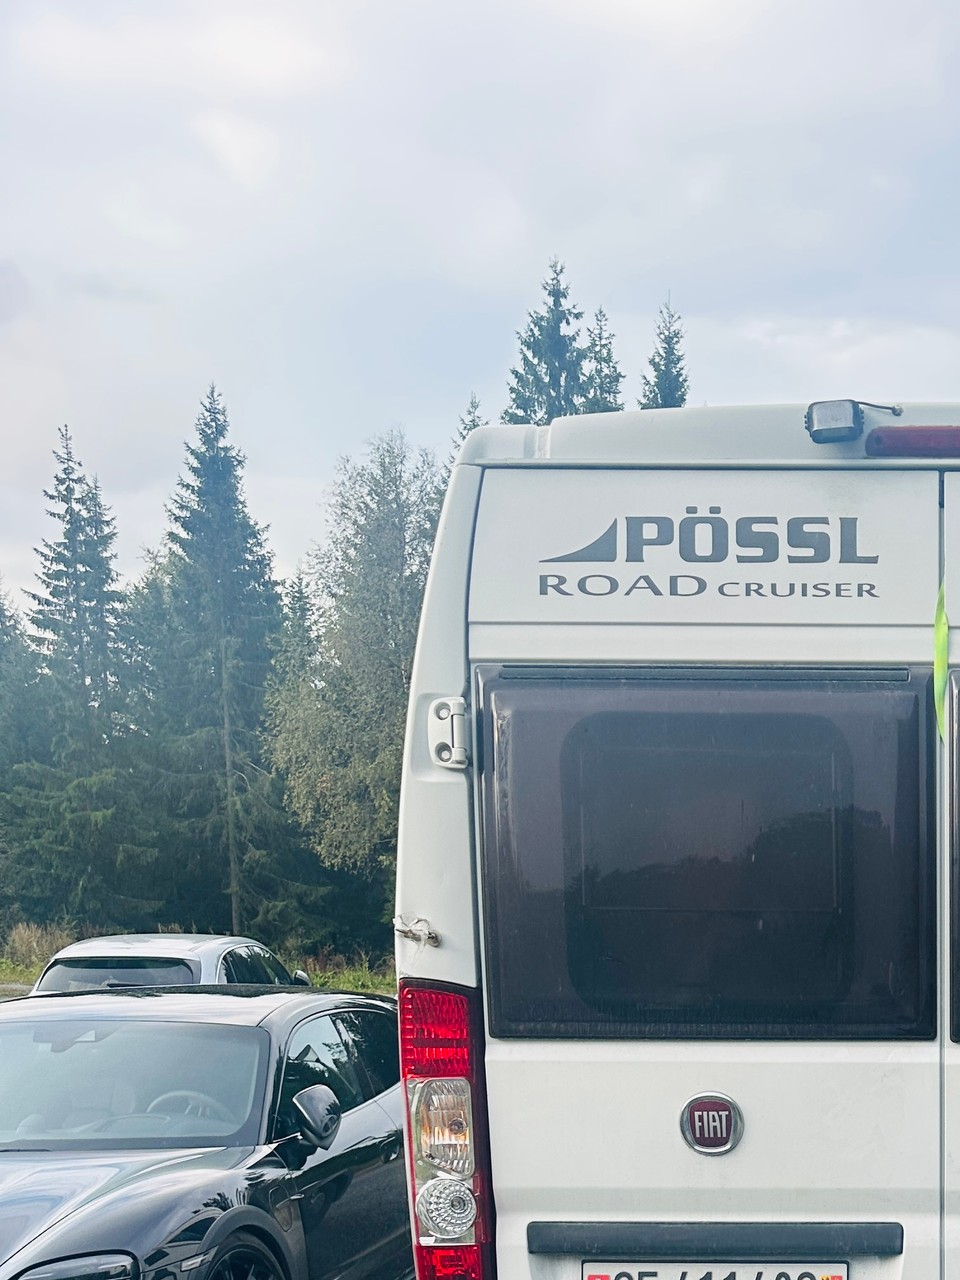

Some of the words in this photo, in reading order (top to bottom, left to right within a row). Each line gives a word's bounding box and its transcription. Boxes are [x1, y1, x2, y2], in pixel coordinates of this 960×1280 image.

[625, 506, 879, 564] PÖSSL
[539, 575, 707, 596] ROAD
[718, 582, 880, 597] CRUISER
[694, 1111, 729, 1138] FIAT
